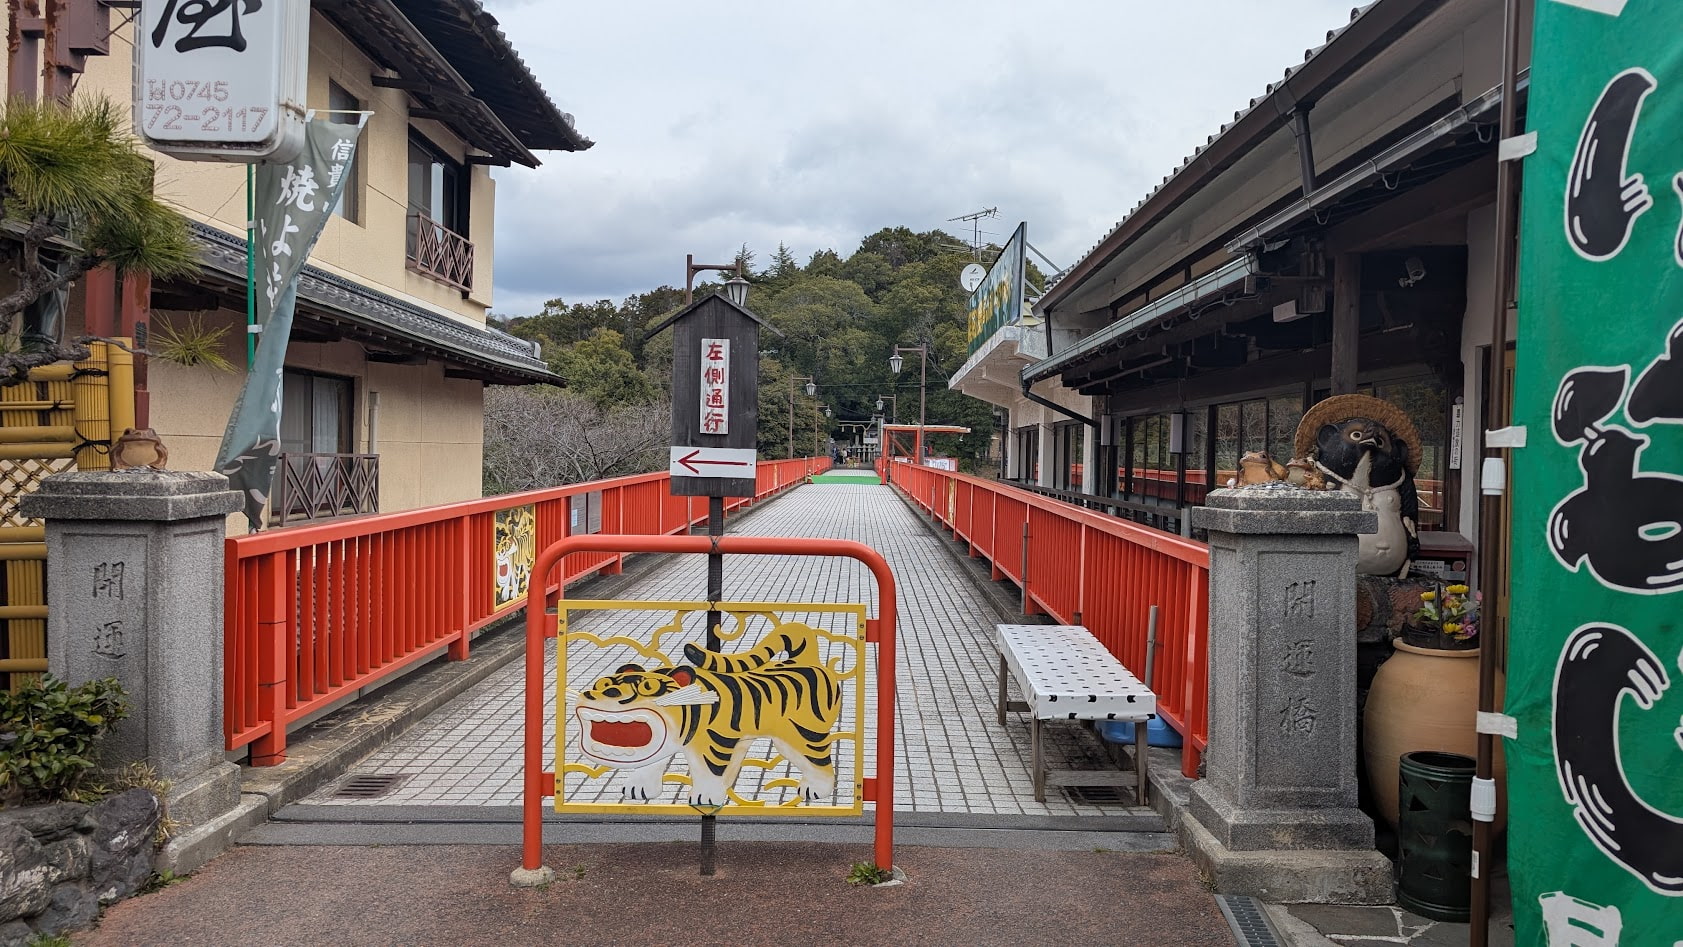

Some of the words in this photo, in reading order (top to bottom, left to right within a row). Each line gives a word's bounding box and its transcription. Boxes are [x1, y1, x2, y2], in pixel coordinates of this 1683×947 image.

[146, 104, 269, 133] 72-2117
[169, 80, 229, 102] 0745
[703, 341, 726, 433] 左側通行
[1279, 579, 1320, 735] 開運橋
